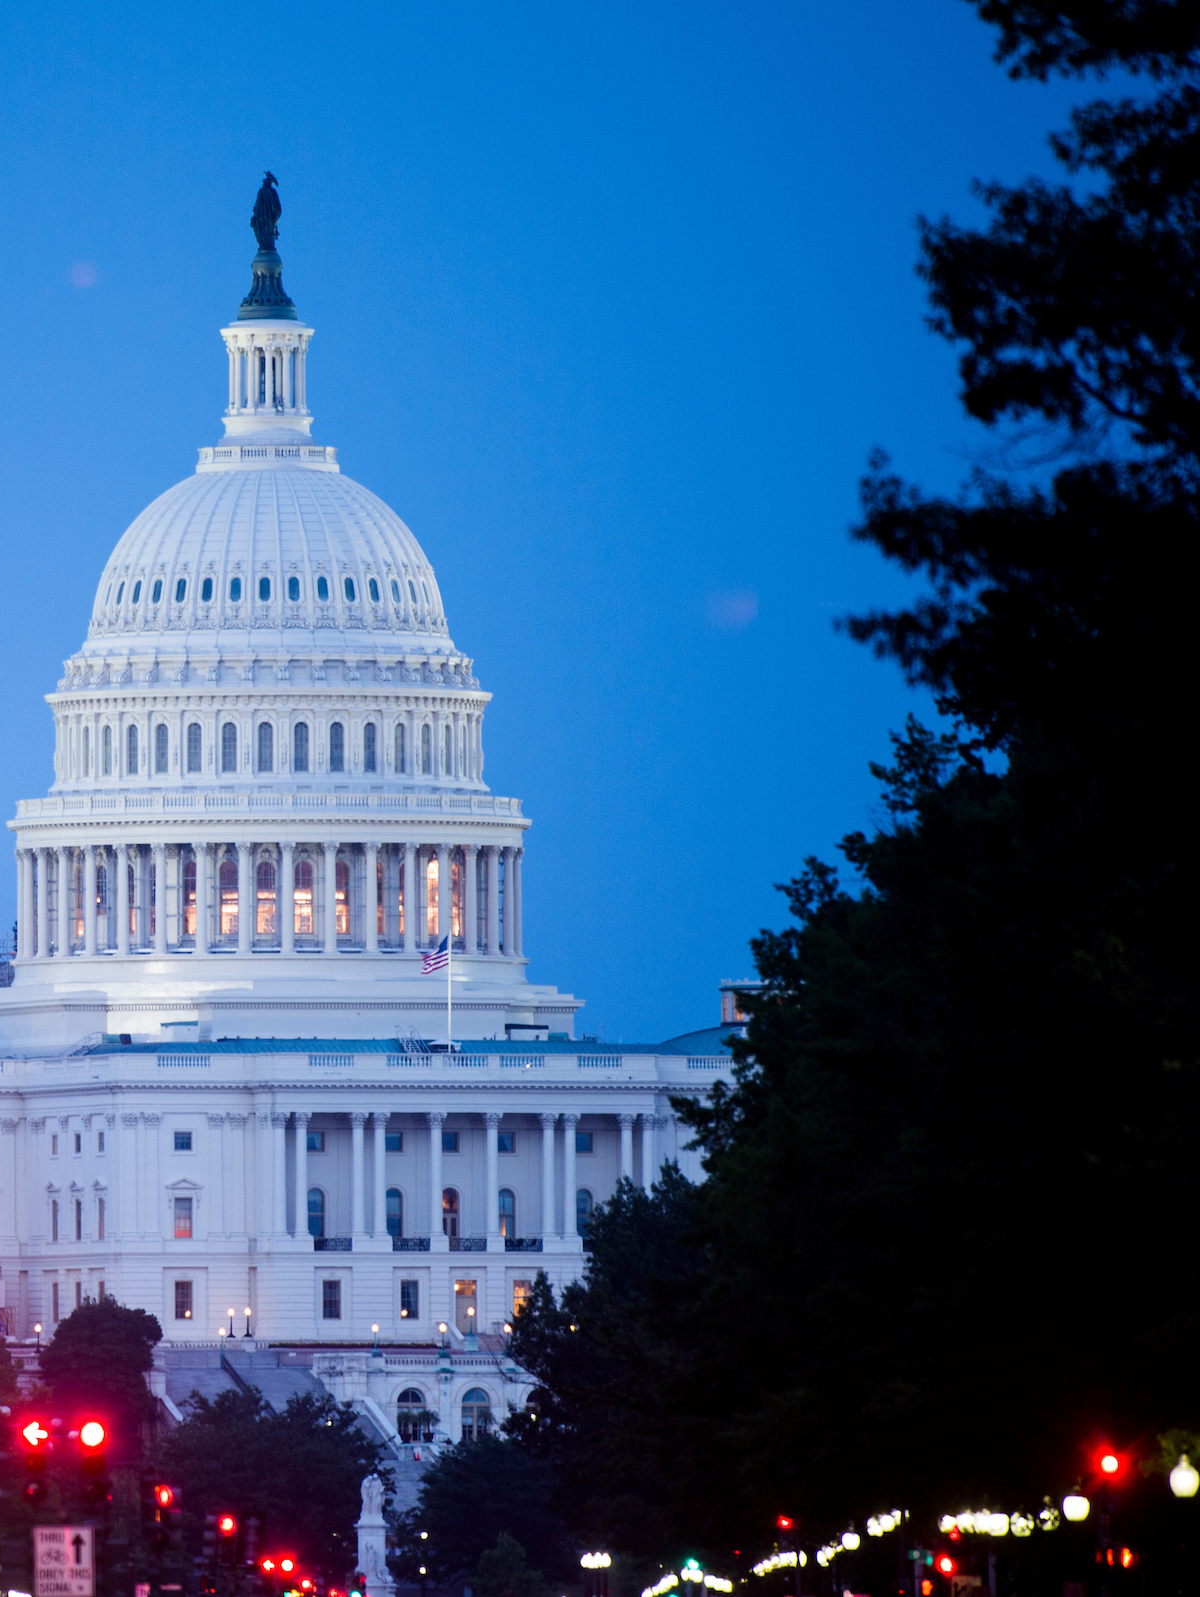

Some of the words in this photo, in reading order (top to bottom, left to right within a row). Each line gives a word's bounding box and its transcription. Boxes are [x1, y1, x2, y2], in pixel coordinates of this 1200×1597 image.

[40, 1532, 65, 1543] THRU
[40, 1568, 65, 1579] OBEY
[70, 1568, 91, 1579] THIS
[40, 1582, 72, 1593] SIGNAL
